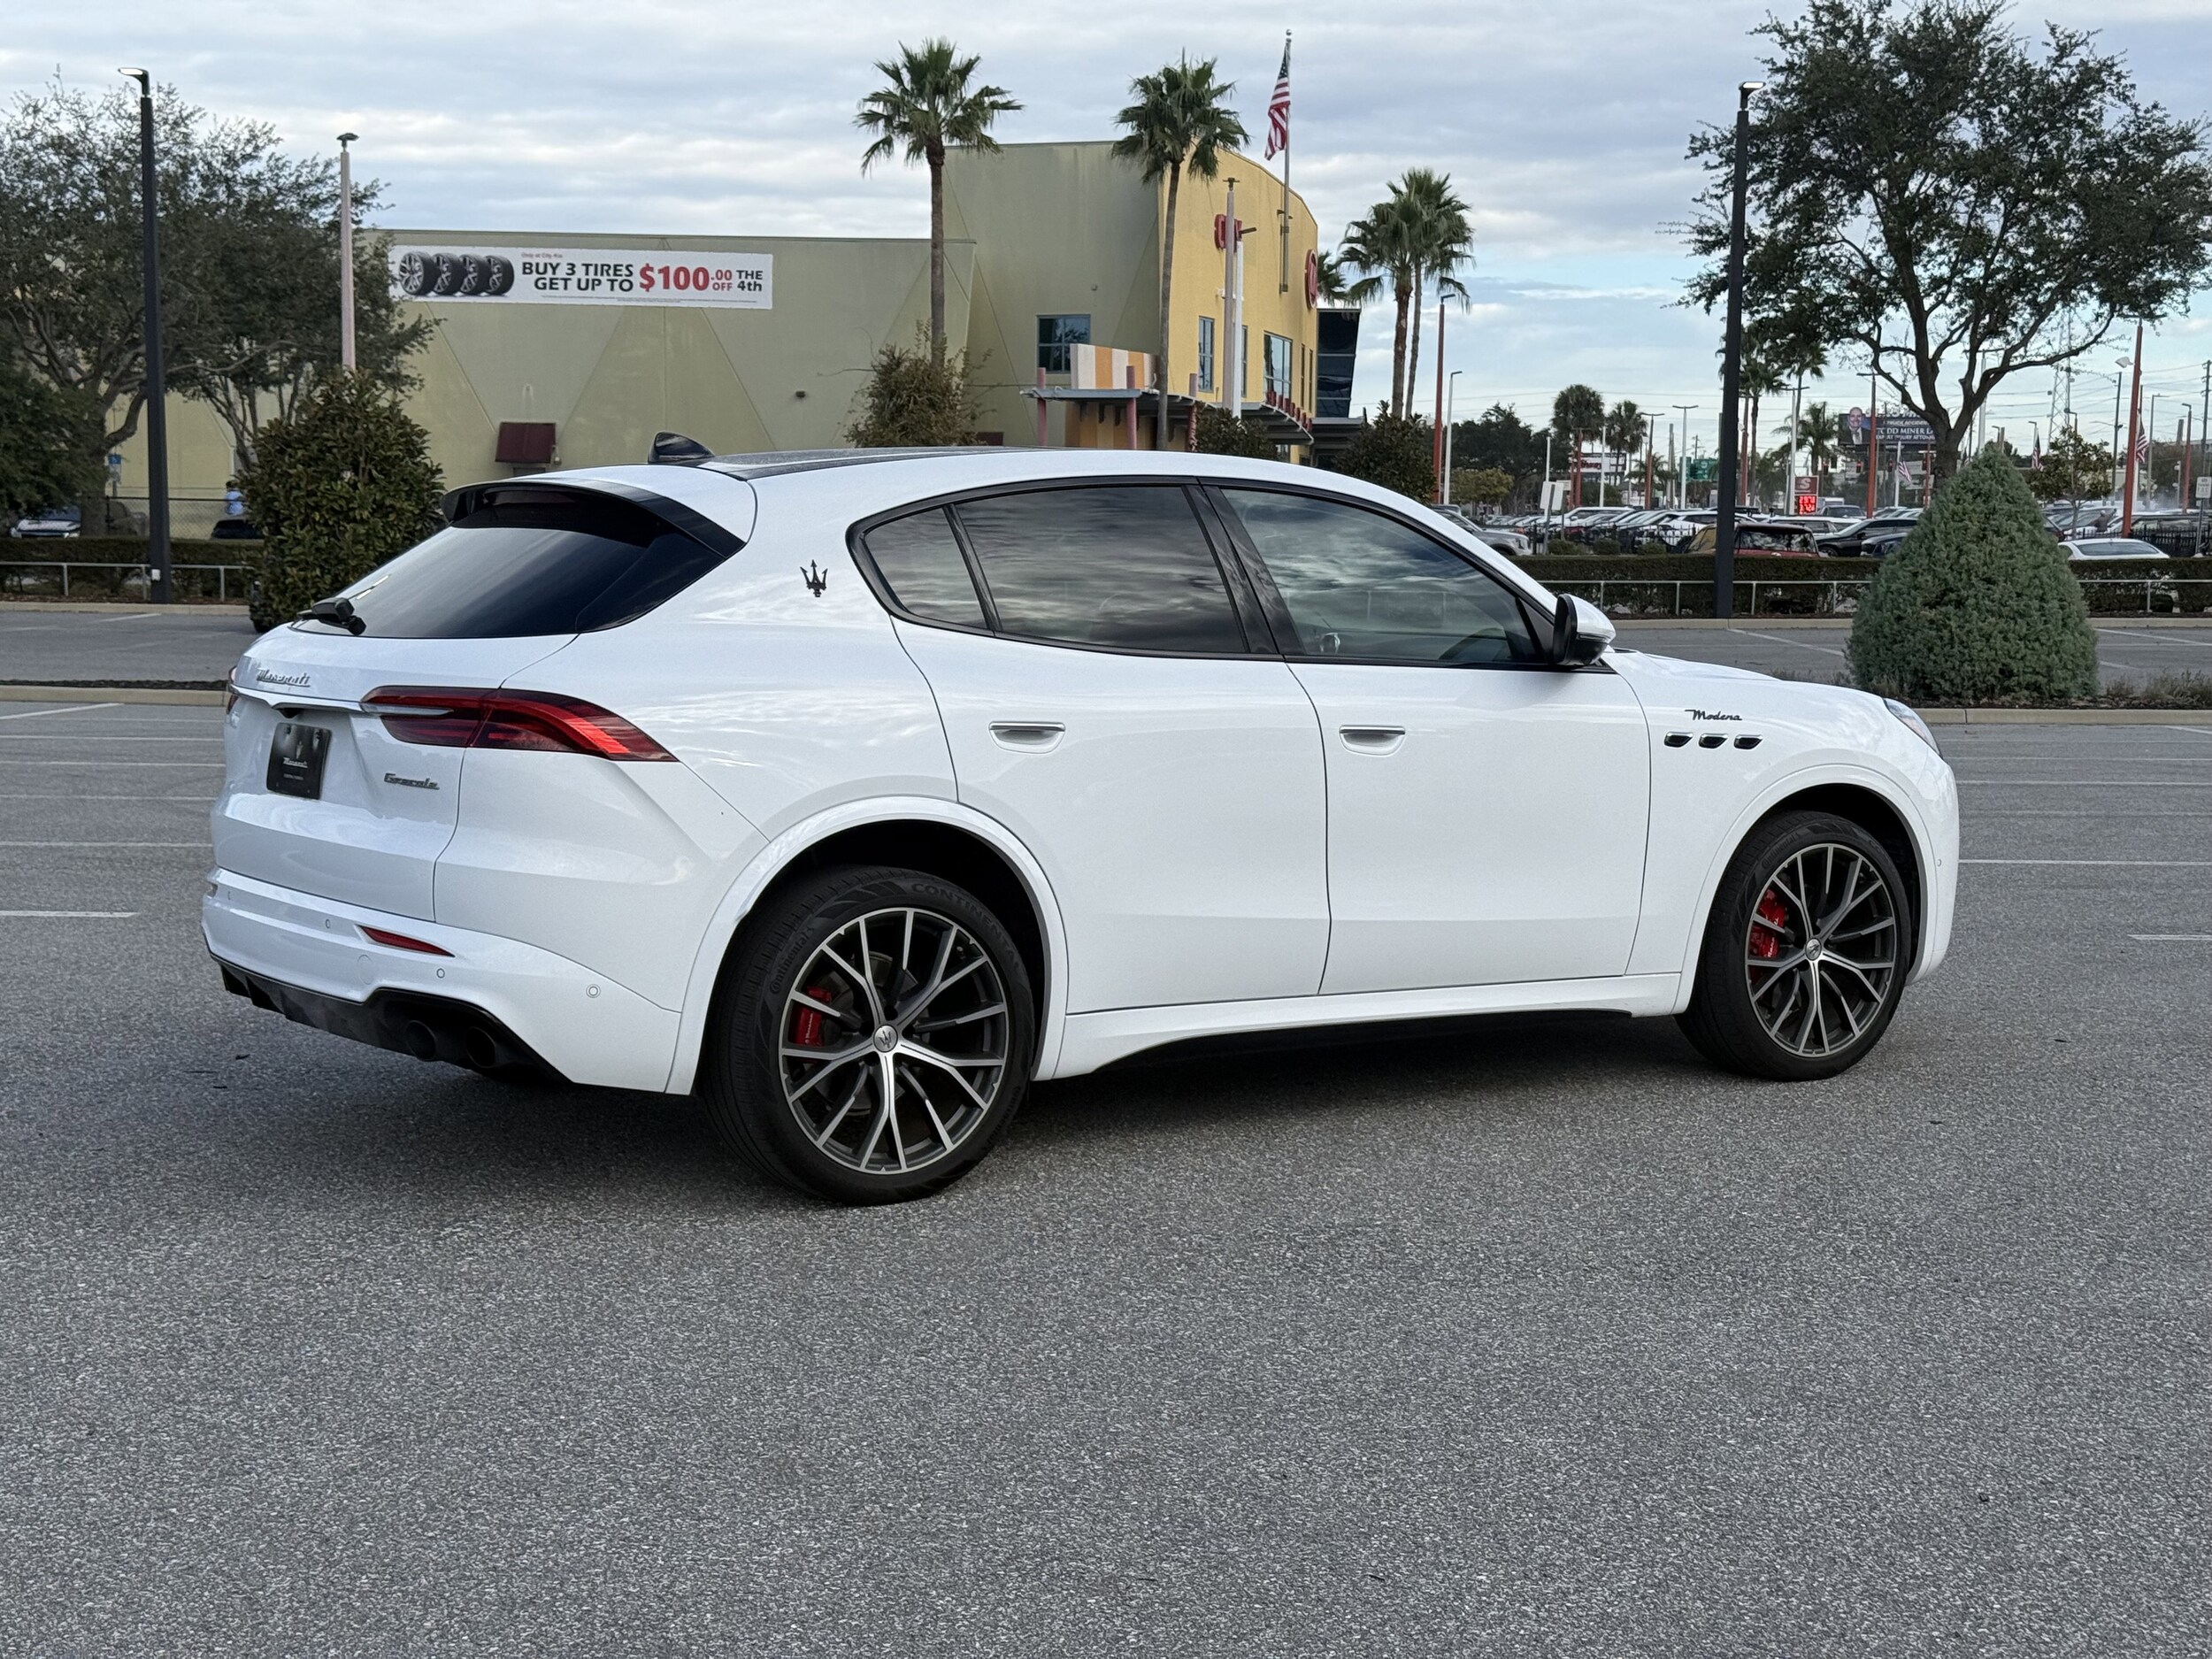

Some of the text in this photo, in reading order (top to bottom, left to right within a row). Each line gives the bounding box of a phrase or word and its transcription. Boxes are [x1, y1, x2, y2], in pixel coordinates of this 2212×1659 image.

[522, 262, 634, 277] BUY 3 TIRES
[736, 270, 764, 280] THE
[534, 277, 634, 292] GET UP TO
[712, 282, 733, 291] OFF
[737, 280, 763, 292] 4th
[257, 668, 311, 687] Maserati
[1685, 709, 1743, 721] Modena
[384, 772, 440, 790] Grecale
